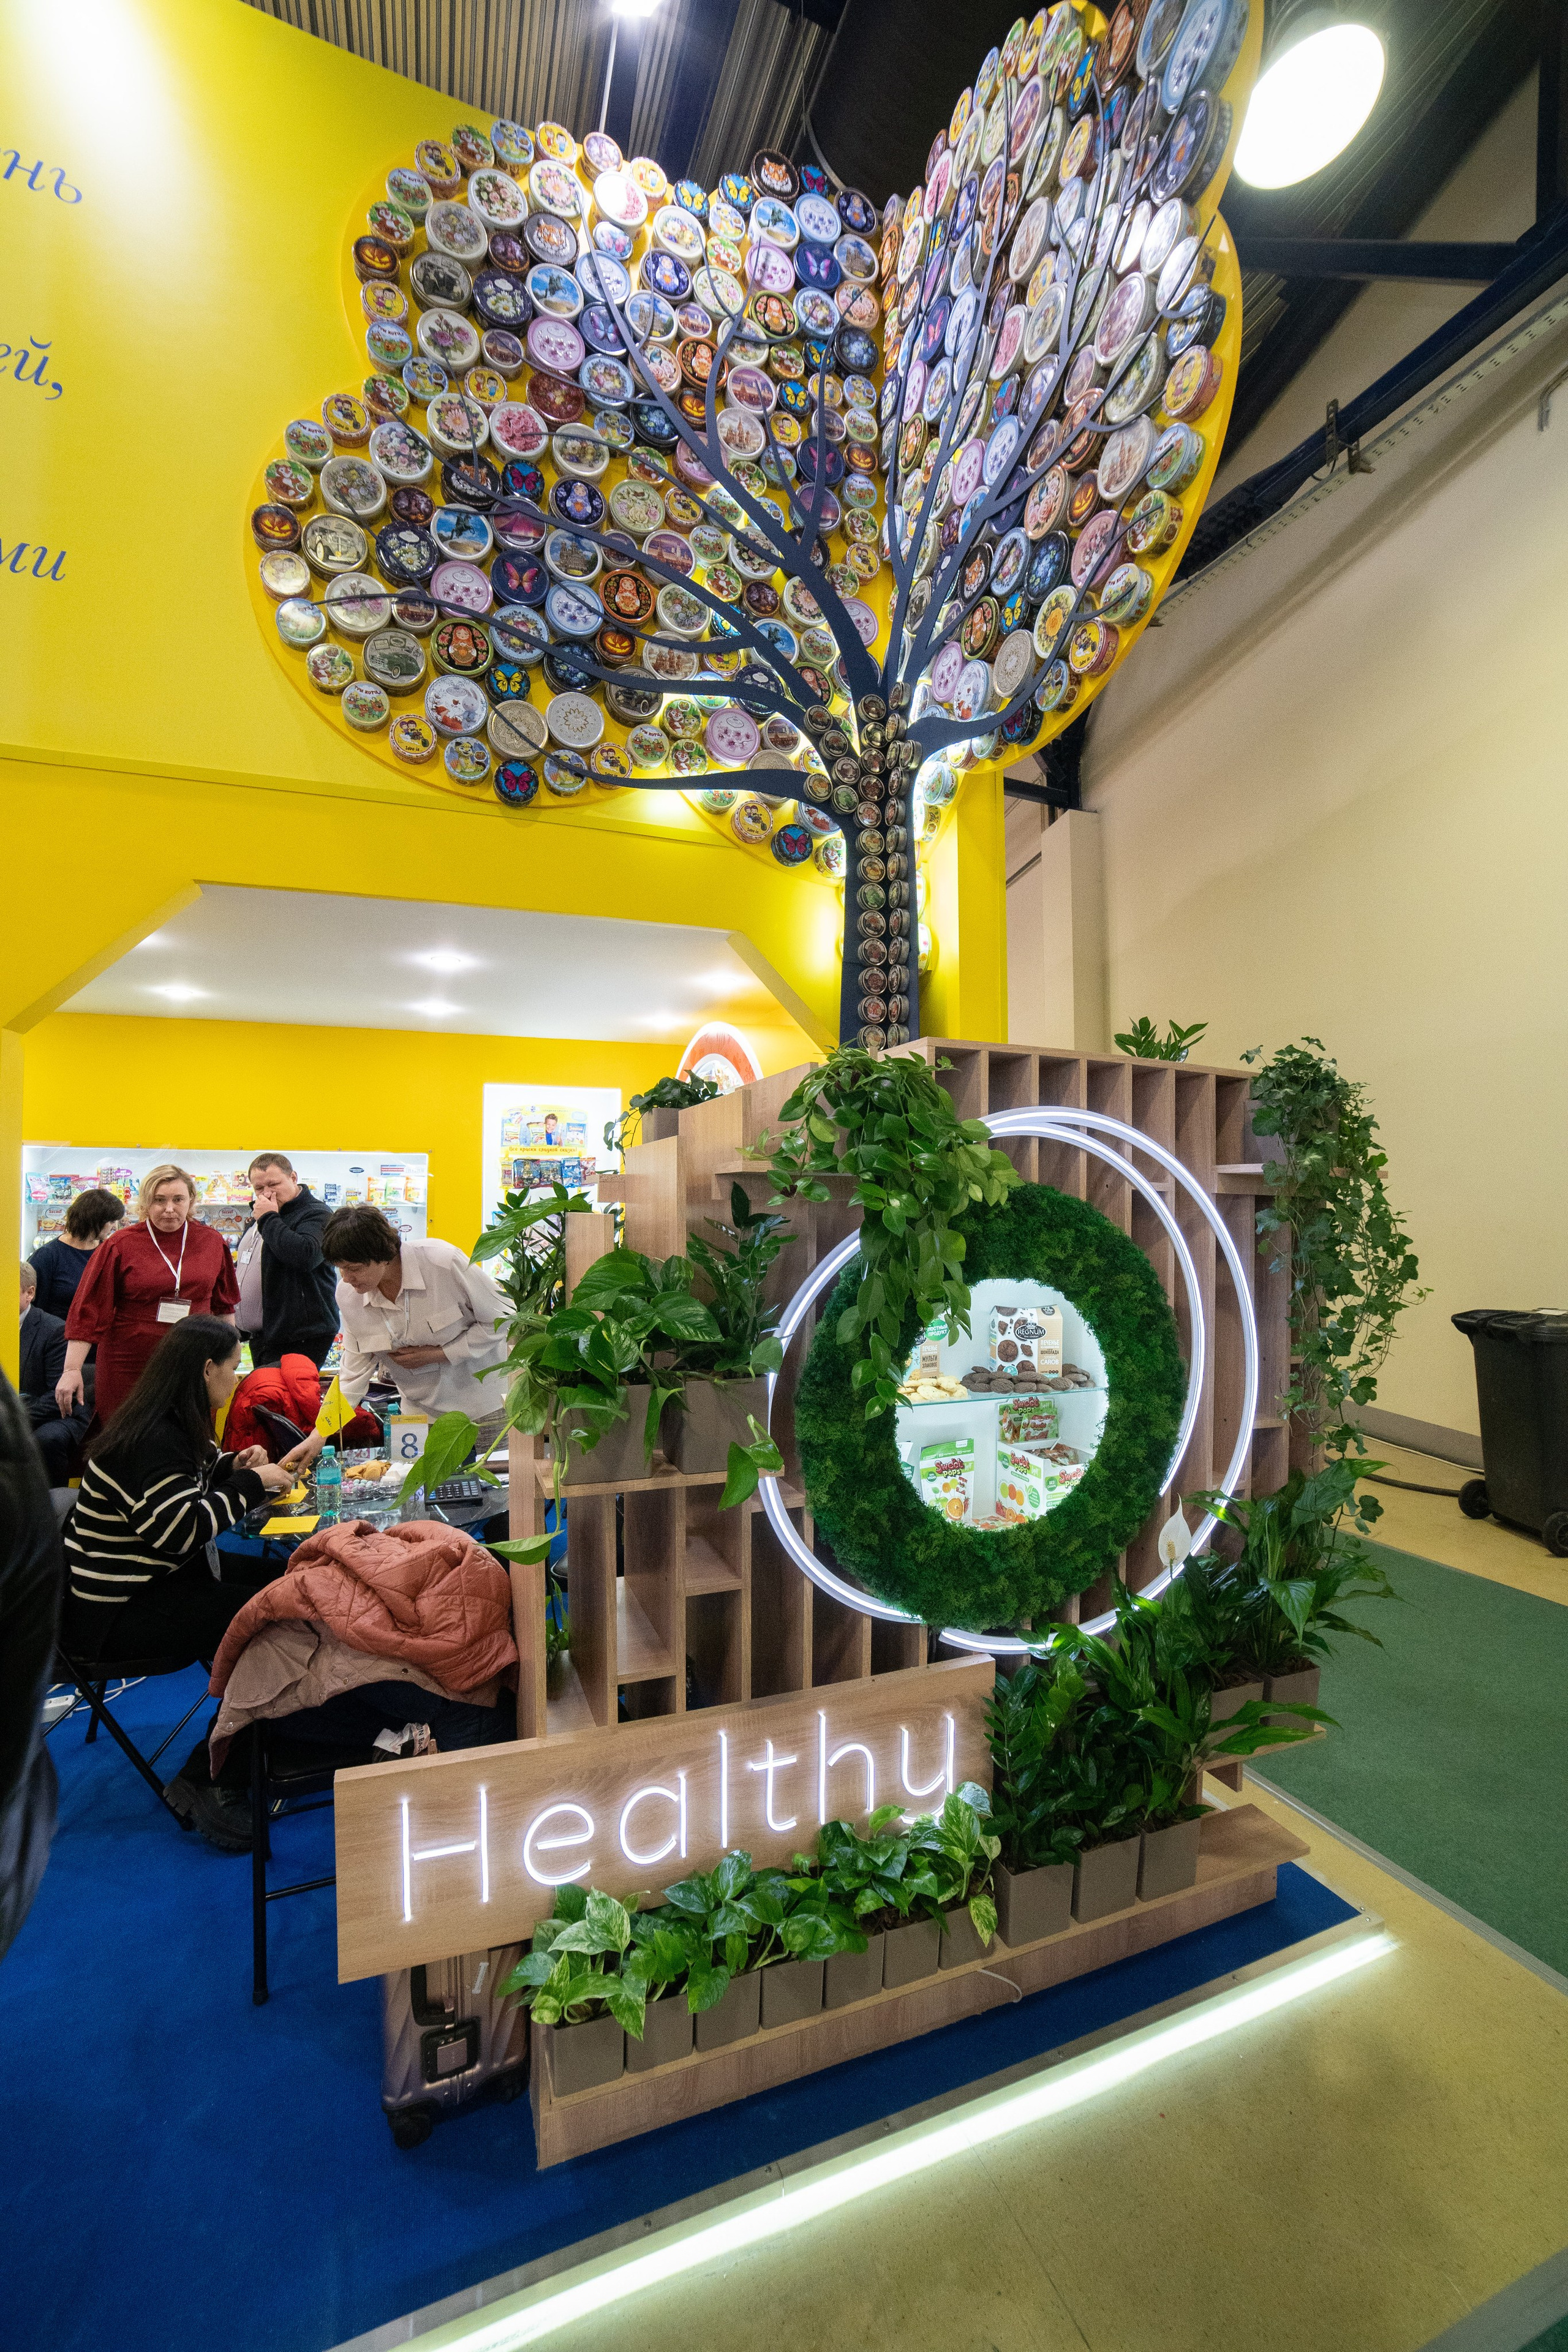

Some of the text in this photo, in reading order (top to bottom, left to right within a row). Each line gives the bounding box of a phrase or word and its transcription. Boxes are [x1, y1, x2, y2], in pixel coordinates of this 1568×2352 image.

[0, 147, 82, 204] нь
[927, 1323, 948, 1332] ПОСТНЫЙ
[1012, 1396, 1039, 1411] Sweet
[401, 1433, 418, 1459] 8
[935, 1458, 965, 1474] Sweet
[1011, 1450, 1030, 1471] Sweet
[398, 1711, 957, 1923] Healthy
